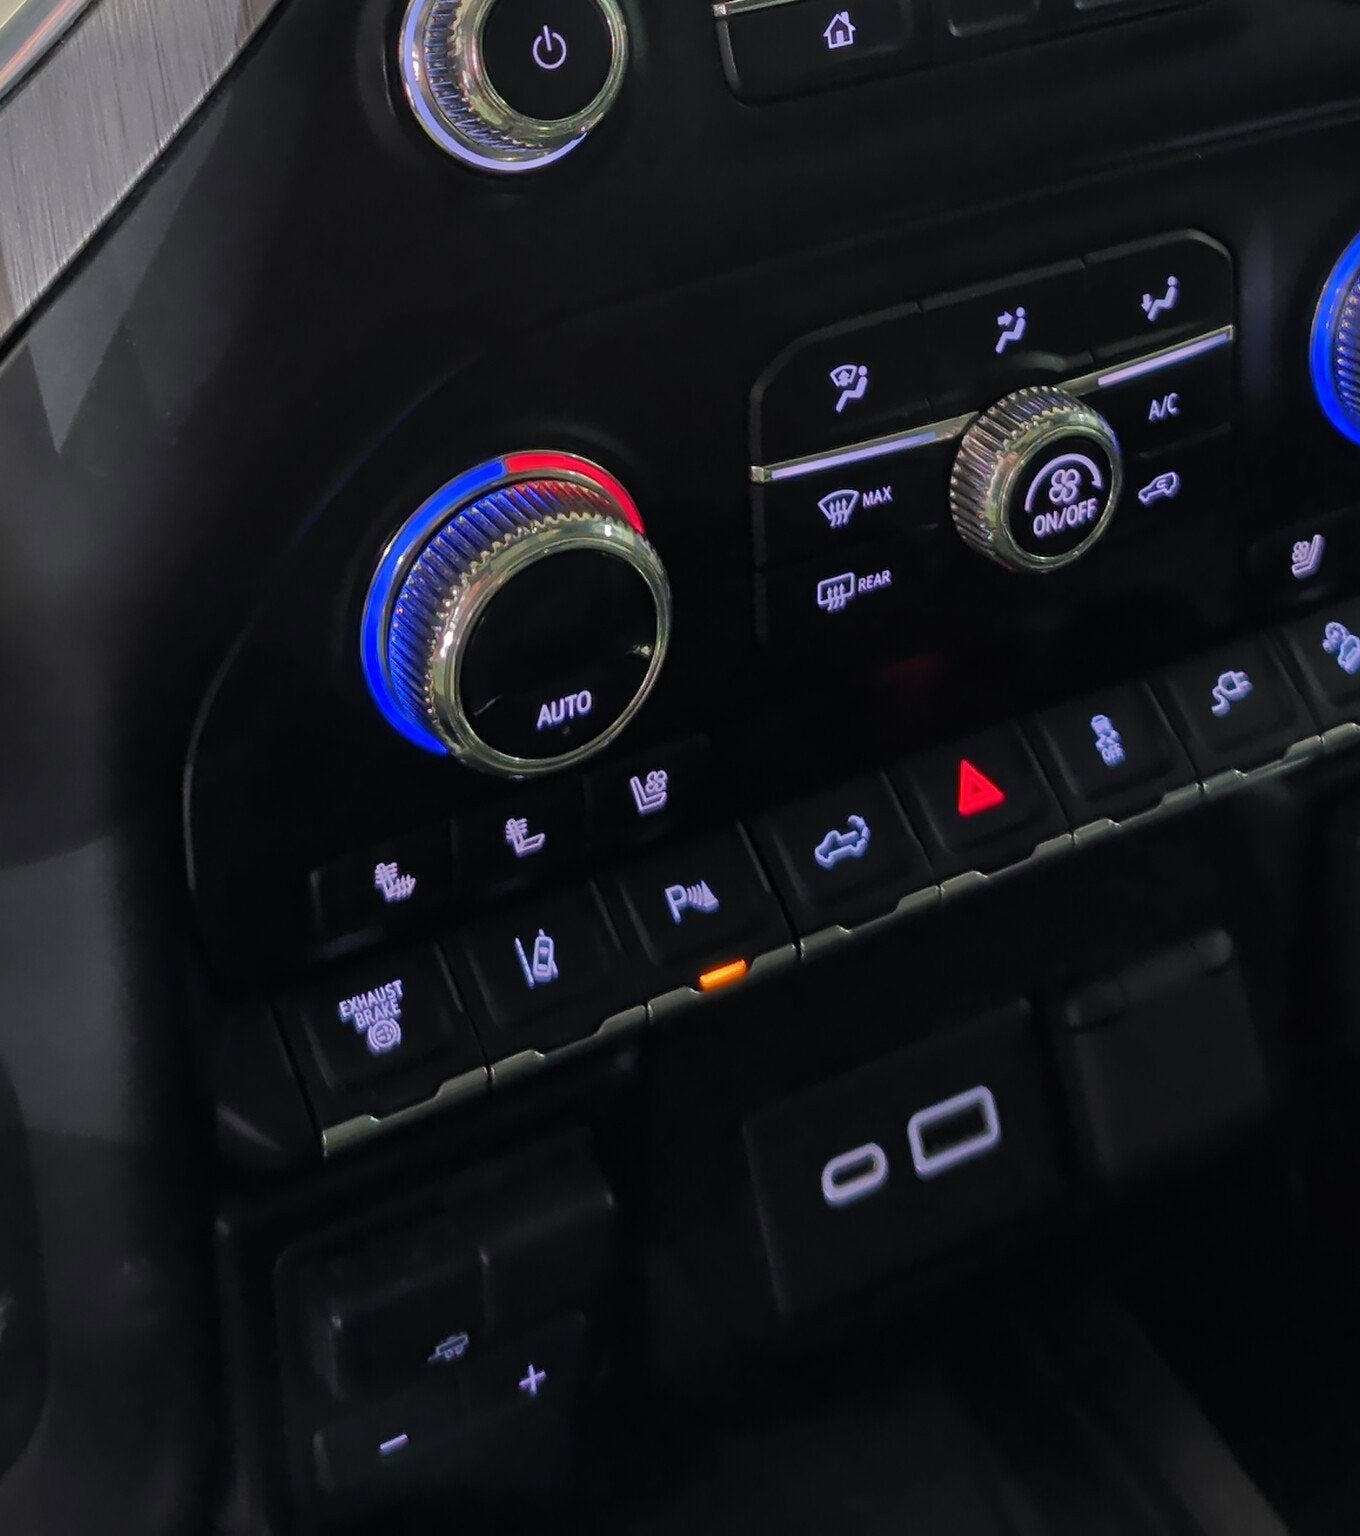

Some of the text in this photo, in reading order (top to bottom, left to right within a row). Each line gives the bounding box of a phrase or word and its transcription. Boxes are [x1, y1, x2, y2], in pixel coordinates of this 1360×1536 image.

[1148, 392, 1178, 420] A/C
[862, 485, 892, 507] MAX
[1033, 498, 1098, 536] ON/OFF
[857, 569, 891, 593] REAR
[536, 690, 592, 730] AUTO
[339, 979, 403, 1019] EXHAUST
[353, 998, 402, 1029] BRAKE
